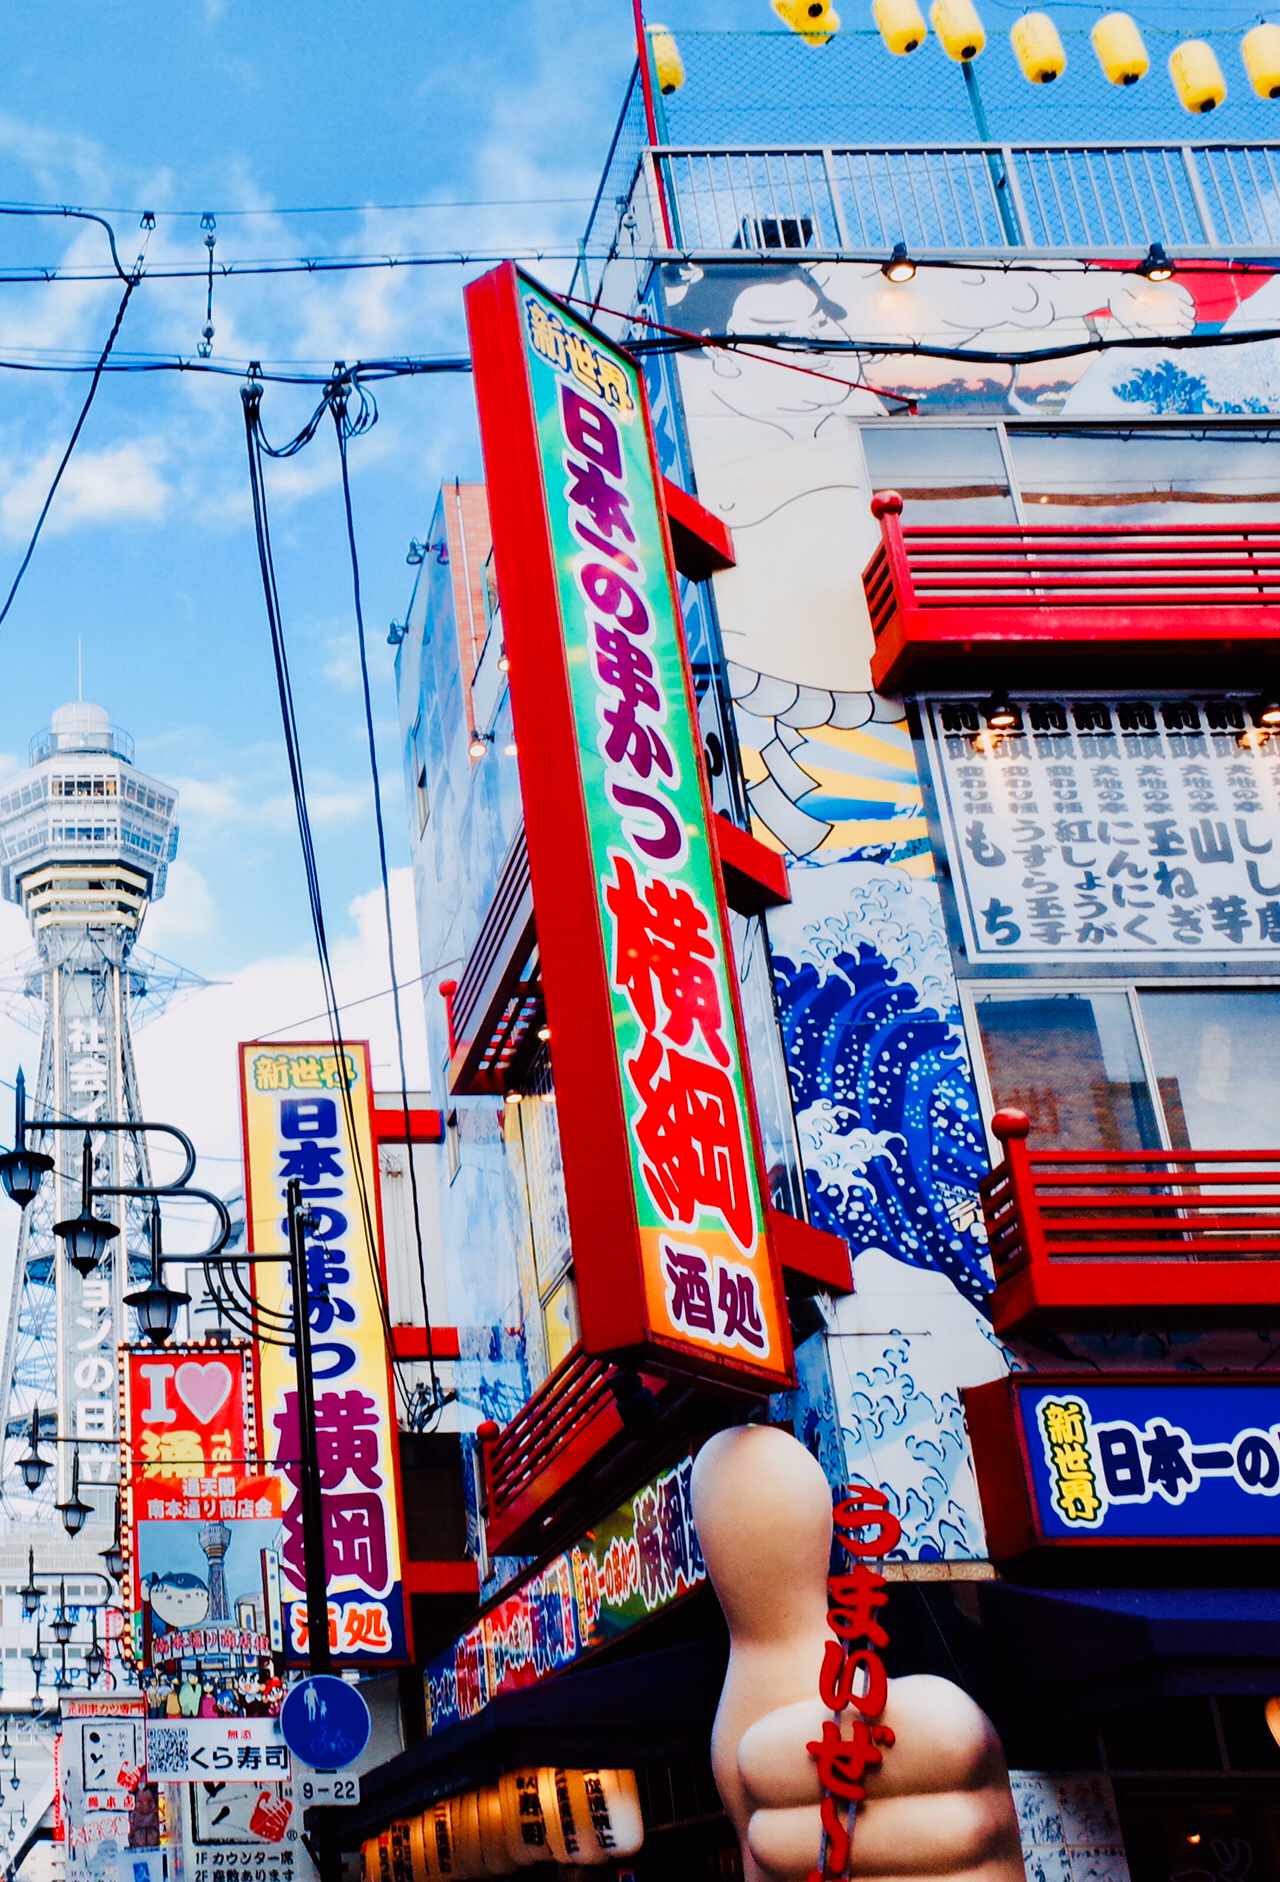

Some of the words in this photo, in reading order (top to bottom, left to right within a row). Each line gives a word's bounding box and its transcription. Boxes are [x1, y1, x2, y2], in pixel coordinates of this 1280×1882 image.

[526, 298, 633, 418] 新世界
[965, 819, 1021, 946] もち
[1012, 819, 1073, 945] うずら玉子
[1052, 819, 1118, 944] 紅しょうが
[1097, 820, 1158, 945] にんにく
[1143, 819, 1205, 945] 玉ねぎ
[1189, 818, 1253, 944] 山芋
[253, 1055, 358, 1091] 新世界
[665, 1244, 764, 1350] 酒処
[147, 1497, 273, 1519] 南本通り商店会
[182, 1478, 236, 1498] 通天閣
[1043, 1402, 1101, 1520] 新世界
[190, 1745, 289, 1770] くら寿司
[195, 1851, 208, 1865] 1F
[212, 1851, 294, 1866] カウンター席
[195, 1870, 209, 1882] 2F
